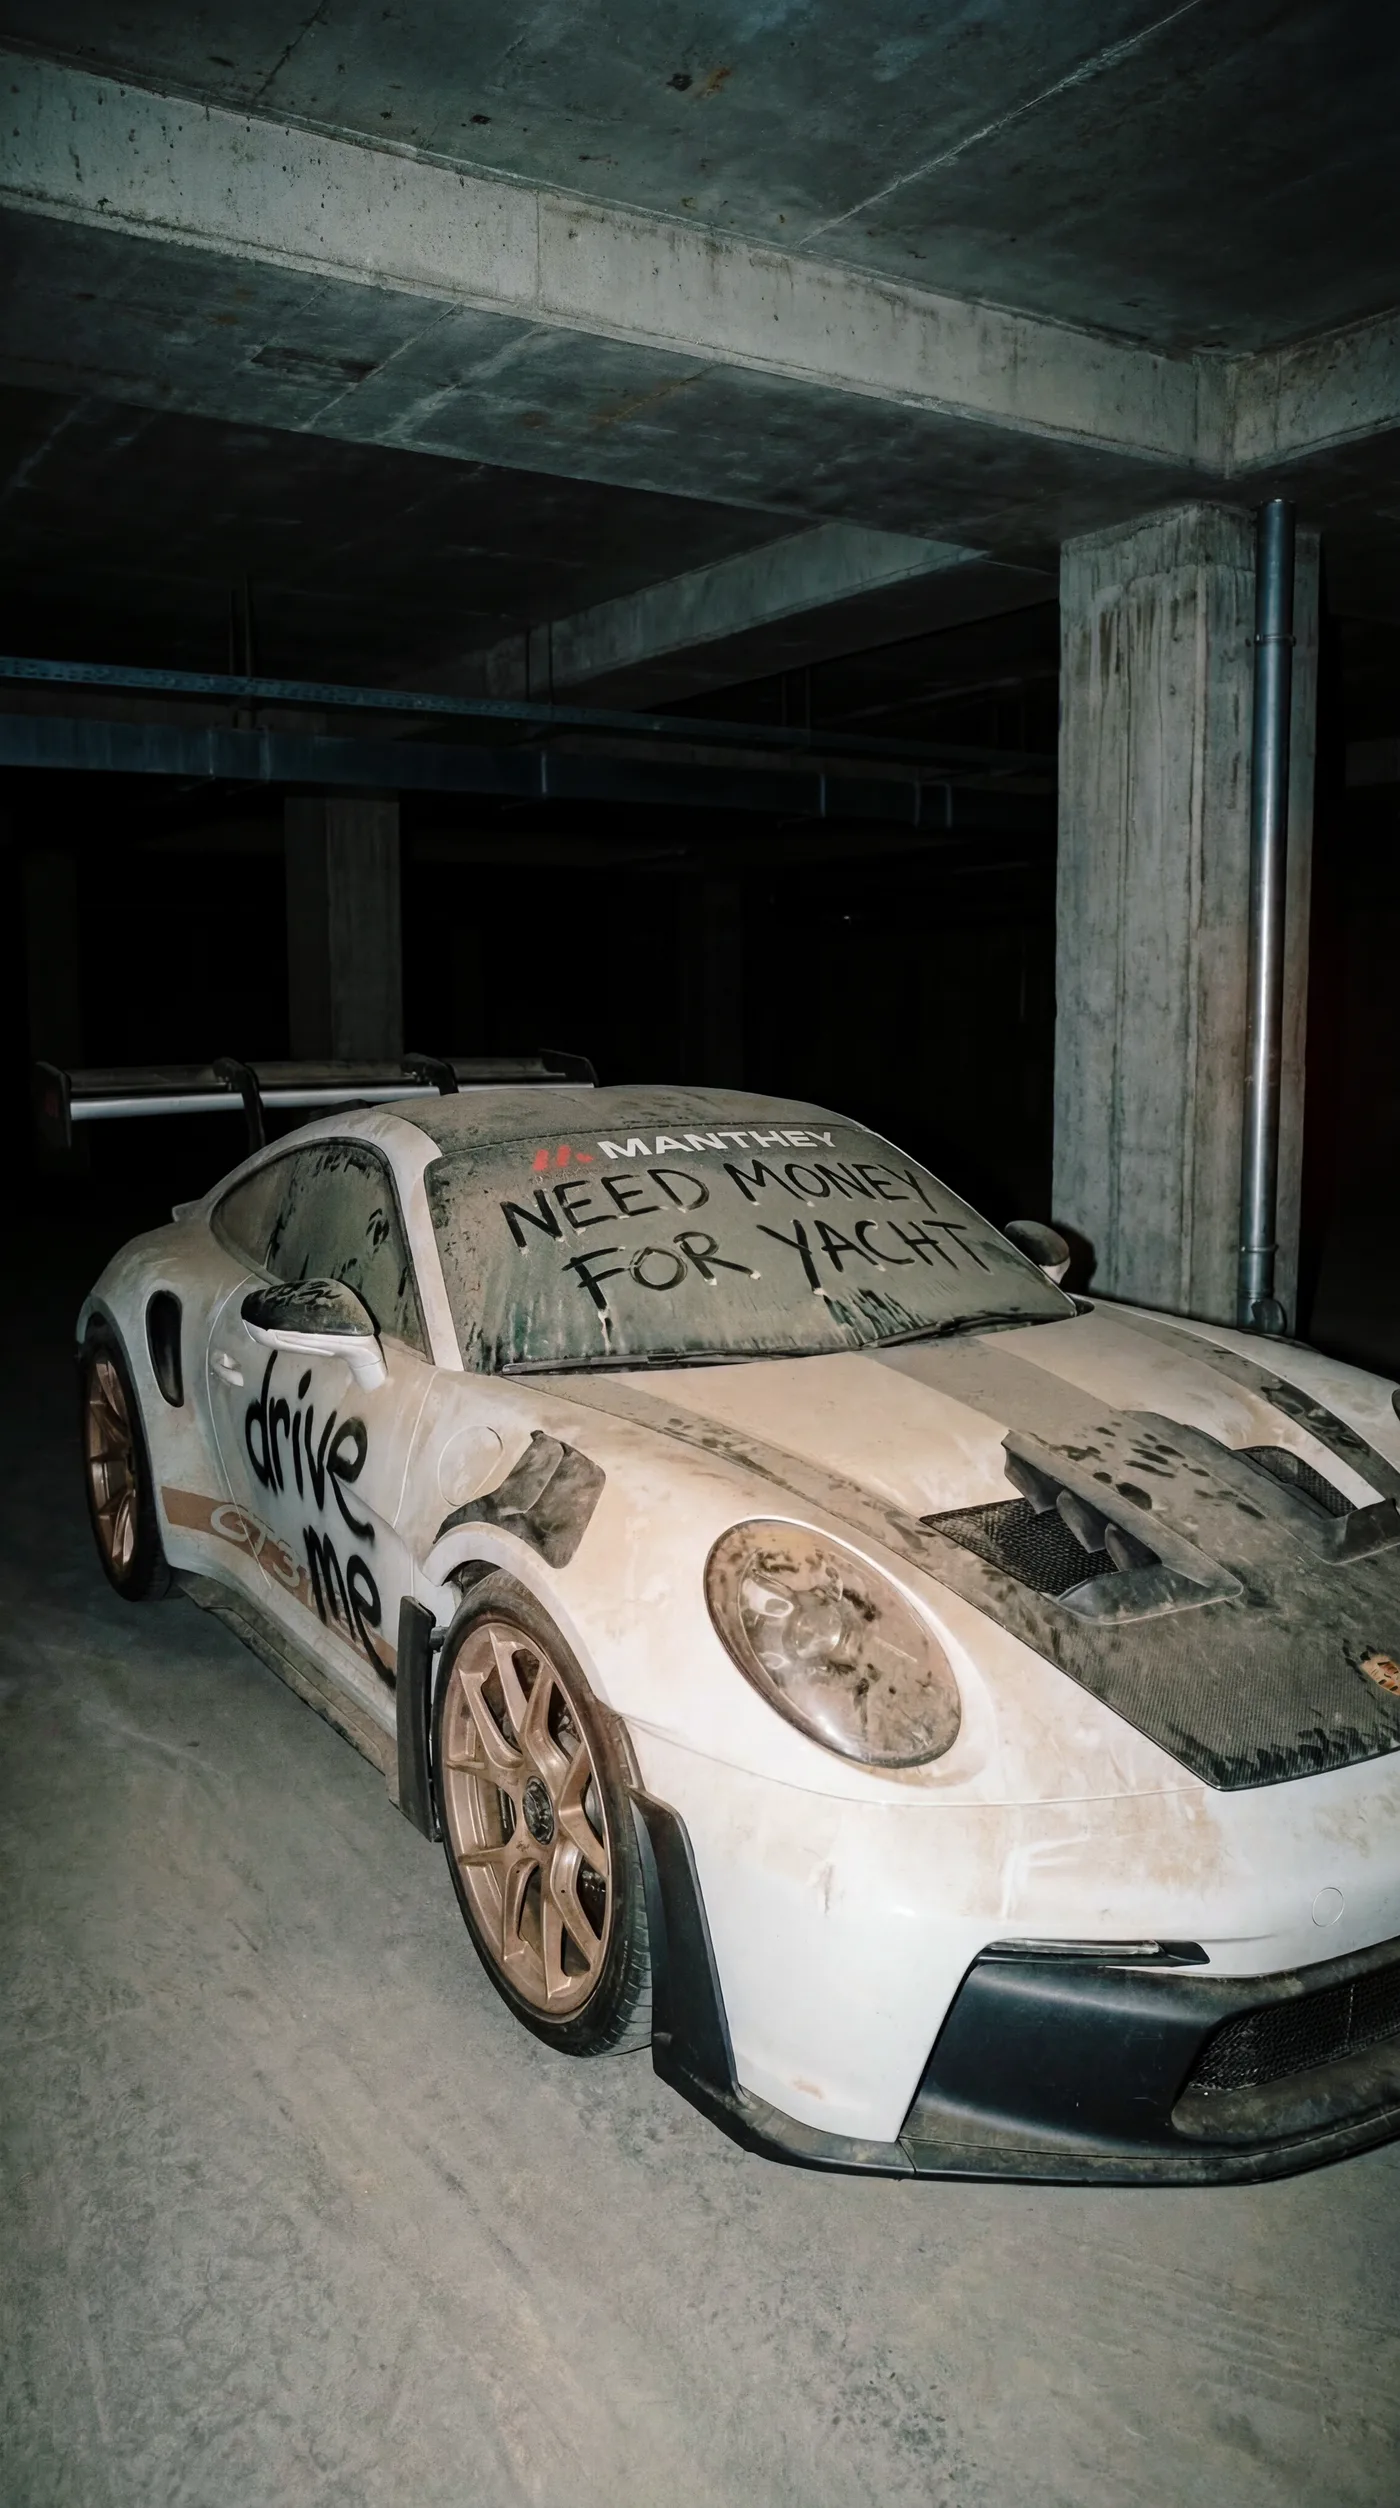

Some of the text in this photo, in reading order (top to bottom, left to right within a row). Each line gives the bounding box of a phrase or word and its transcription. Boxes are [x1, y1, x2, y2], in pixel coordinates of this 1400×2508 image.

[597, 1130, 836, 1160] MANTHEY
[500, 1159, 938, 1250] NEED MONEY
[561, 1218, 993, 1312] FOR YACHT
[245, 1350, 375, 1545] drive
[302, 1525, 398, 1692] me
